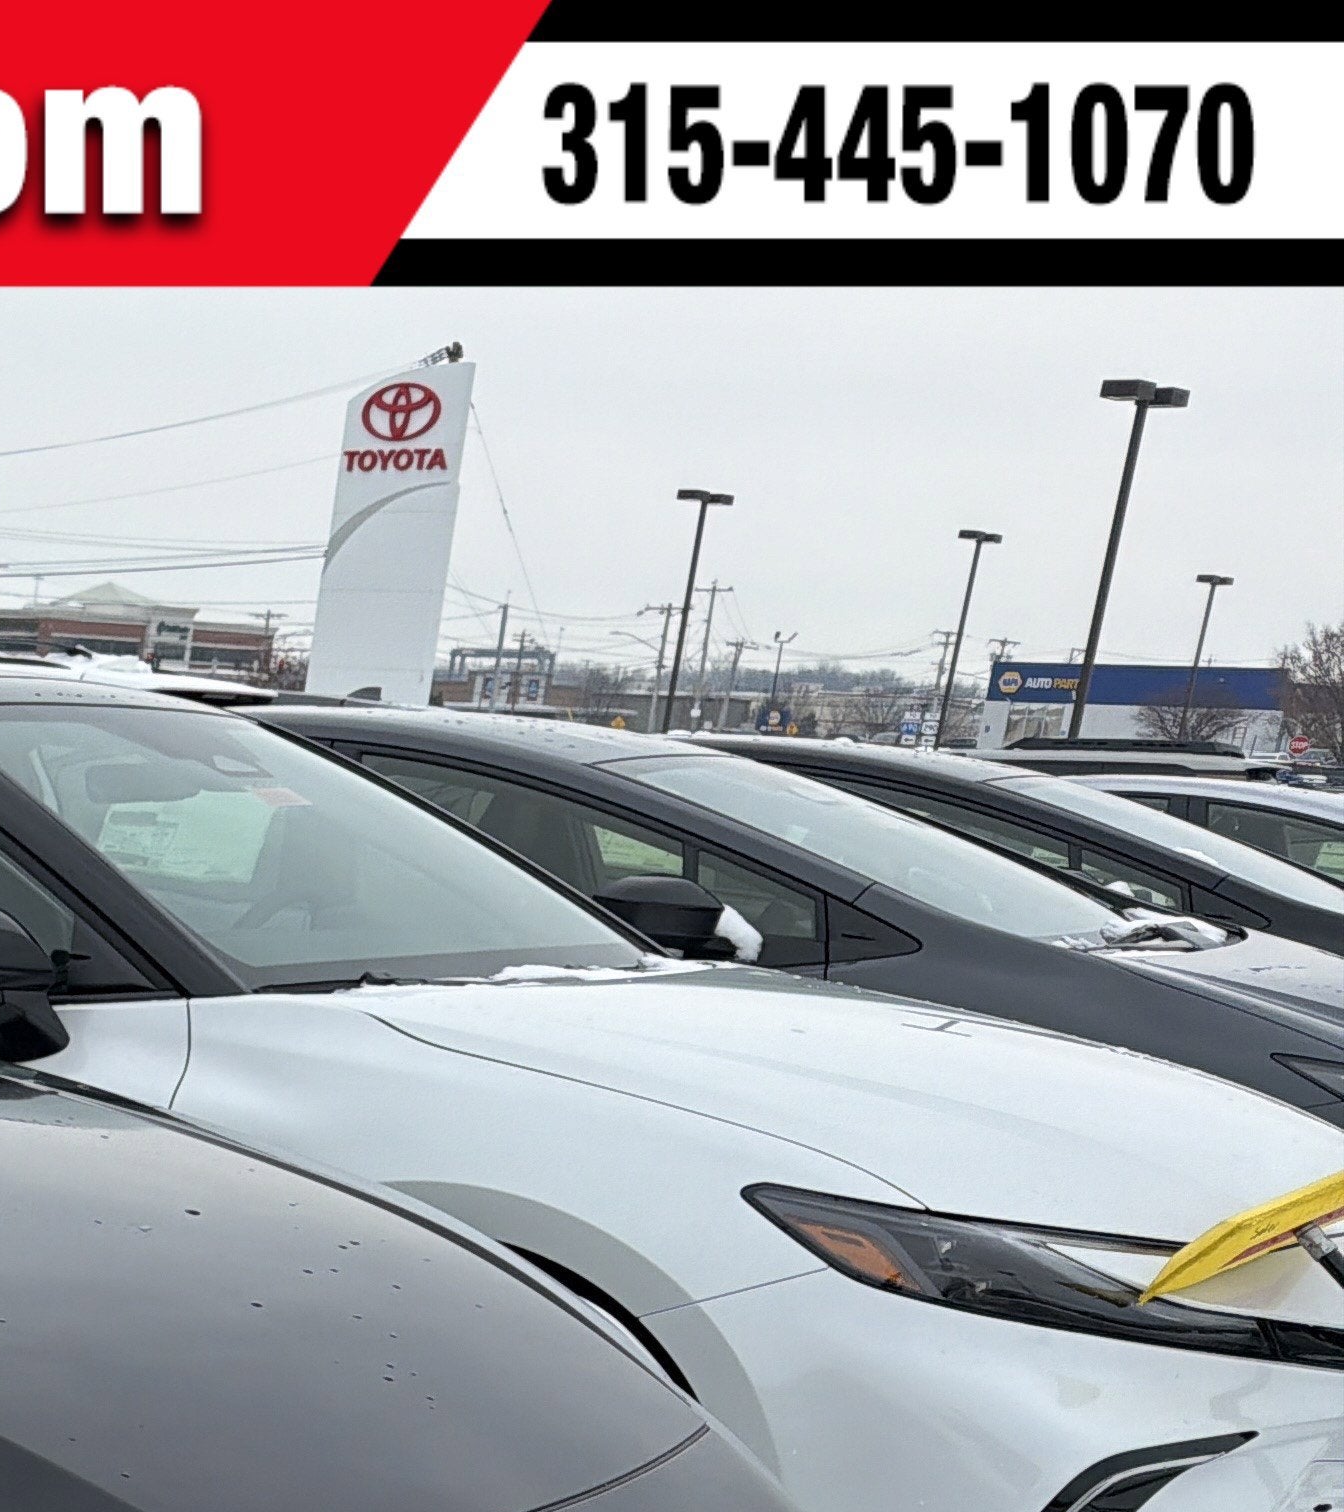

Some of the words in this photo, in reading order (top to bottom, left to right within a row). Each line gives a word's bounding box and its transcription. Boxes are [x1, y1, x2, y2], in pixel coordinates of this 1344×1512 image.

[343, 448, 447, 472] TOYOTA
[1024, 677, 1052, 689] AUTO
[1053, 678, 1080, 689] PART
[1291, 741, 1309, 749] STOP
